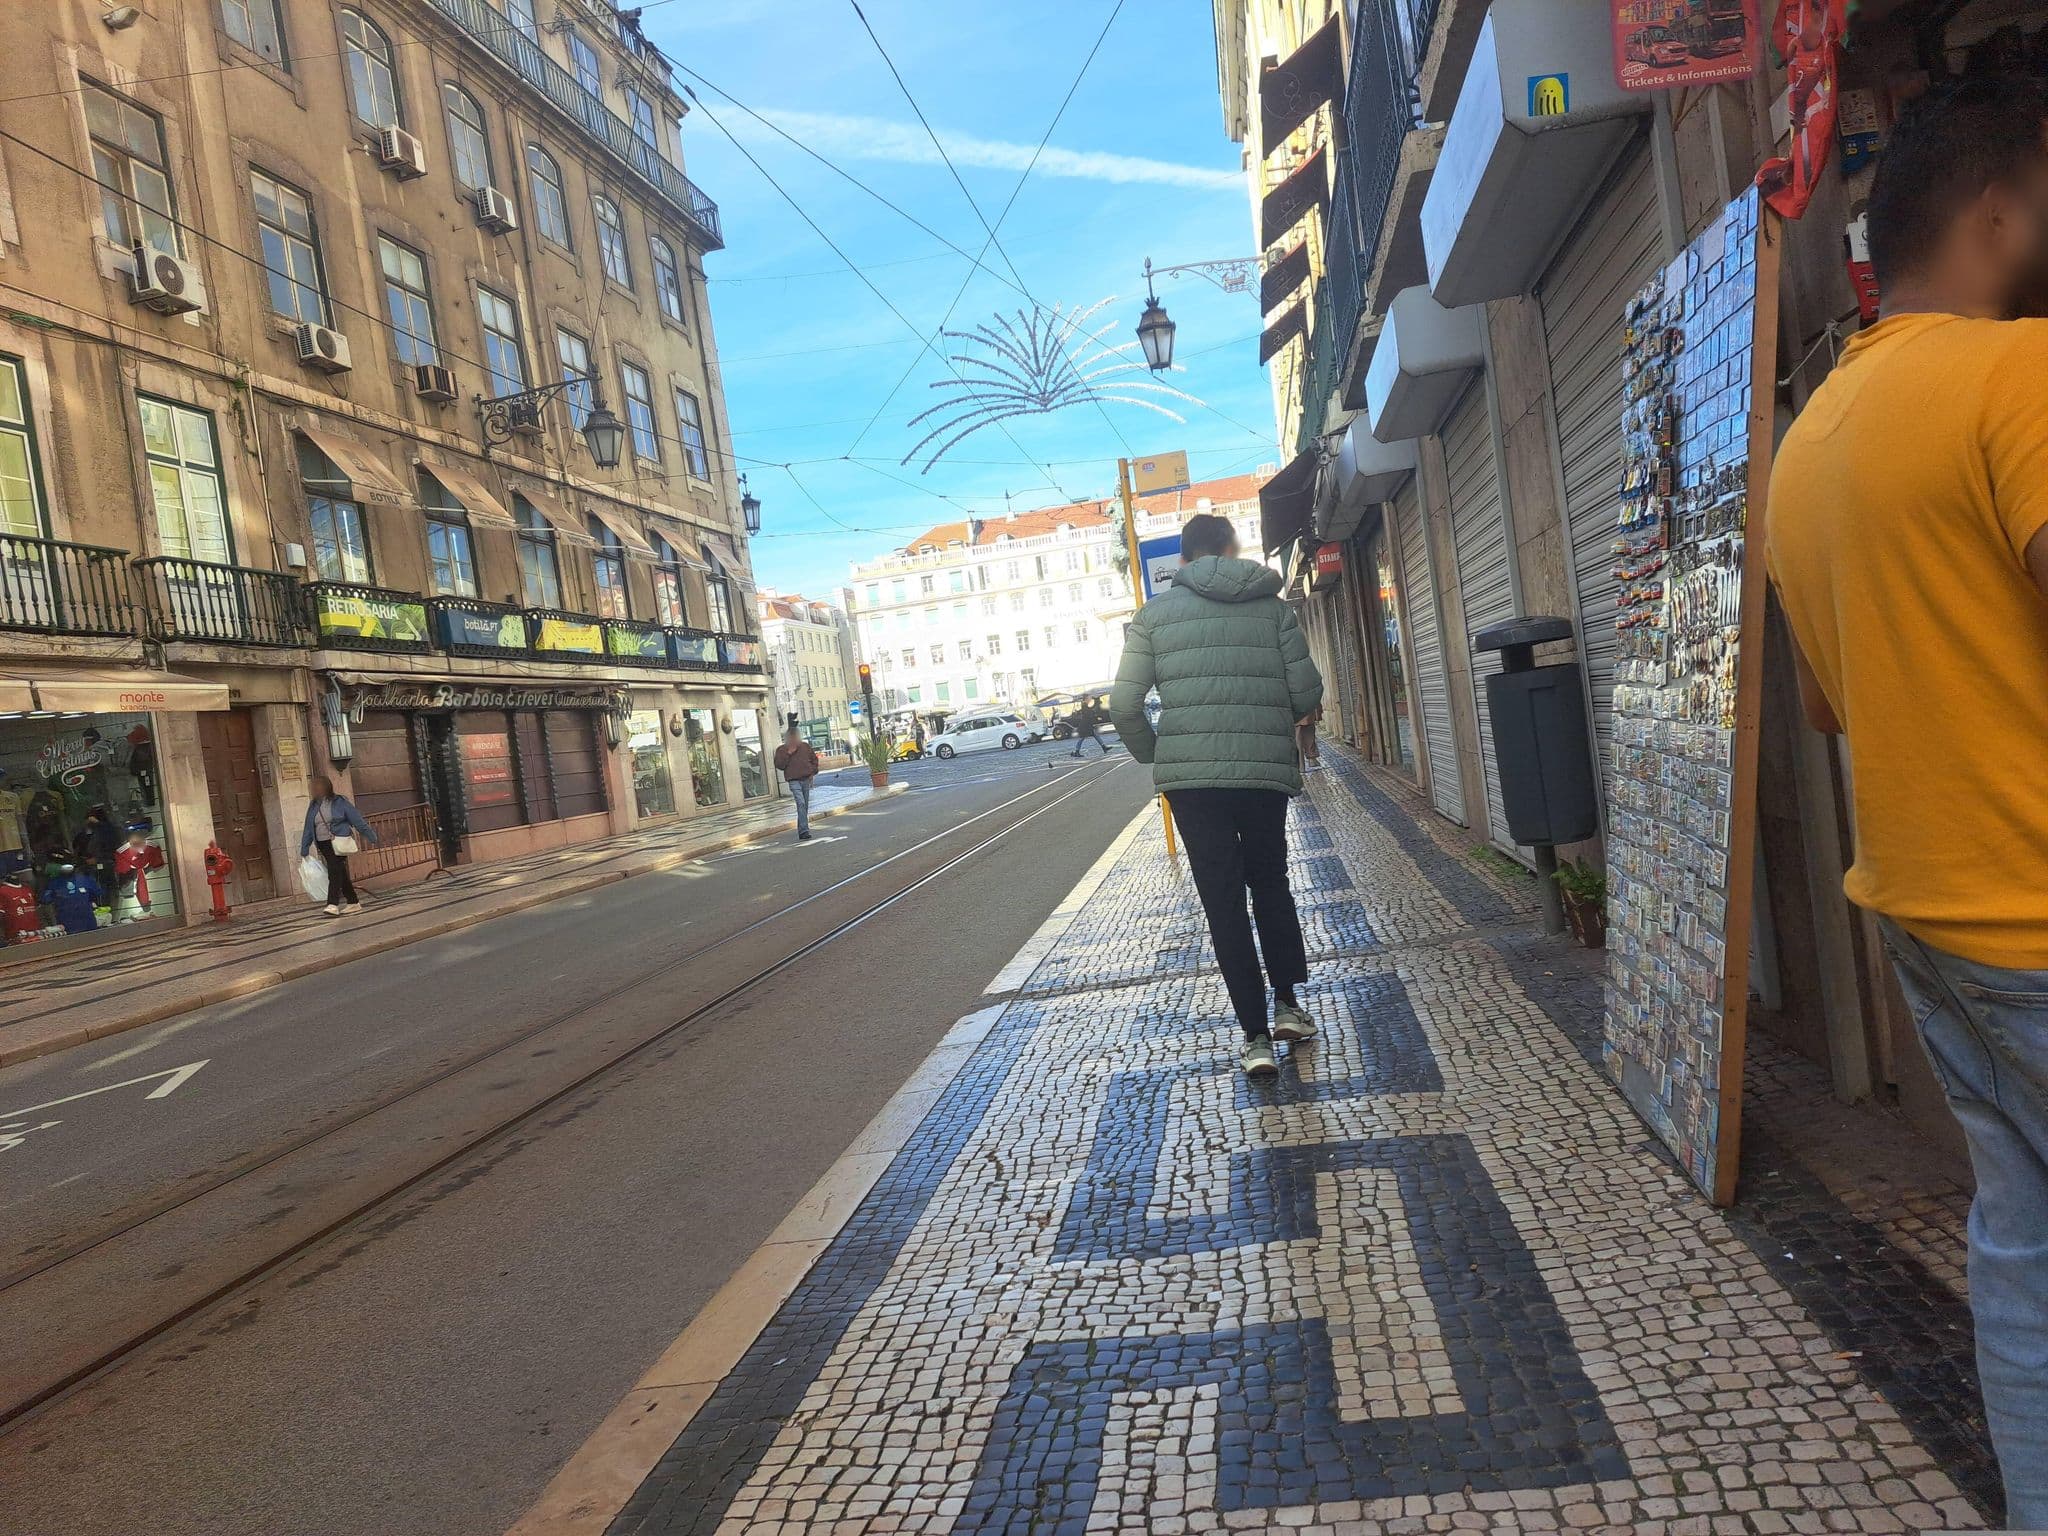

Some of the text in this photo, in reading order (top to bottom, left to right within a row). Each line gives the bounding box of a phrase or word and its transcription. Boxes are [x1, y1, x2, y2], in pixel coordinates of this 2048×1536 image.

[1624, 64, 1753, 88] Tickets & Informations
[326, 598, 399, 621] RETROSARIA
[120, 690, 165, 703] monte
[120, 703, 148, 711] branco
[43, 736, 88, 759] Merry
[35, 749, 101, 782] Christmas
